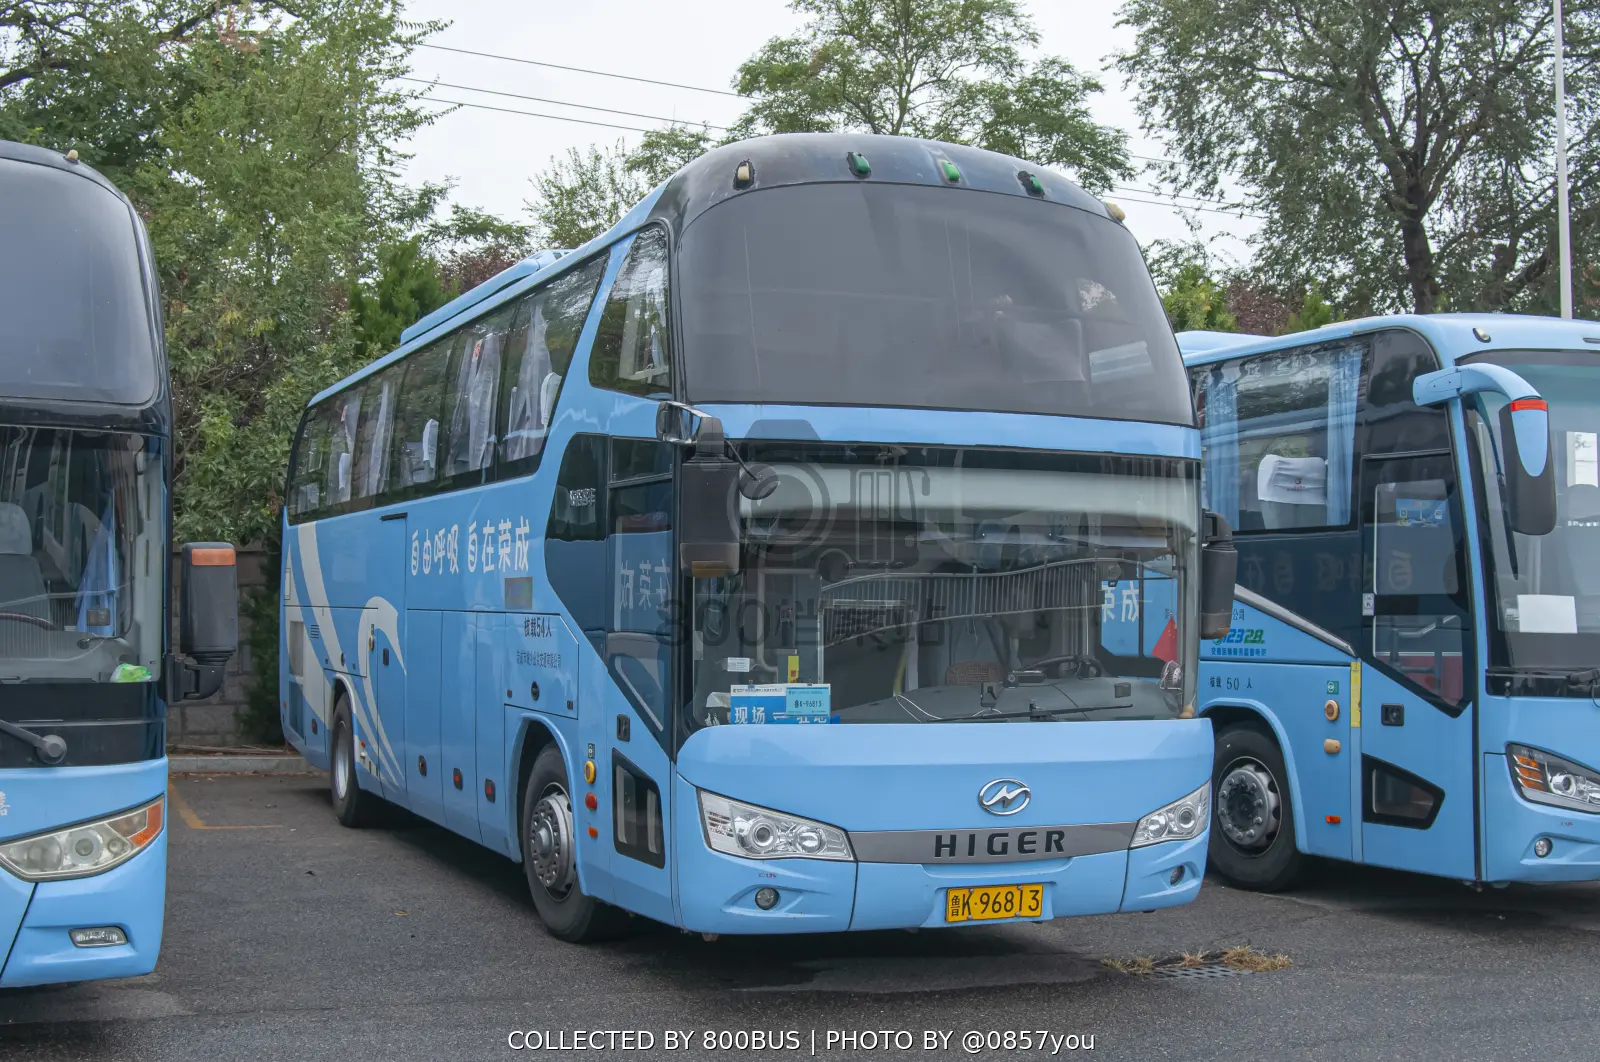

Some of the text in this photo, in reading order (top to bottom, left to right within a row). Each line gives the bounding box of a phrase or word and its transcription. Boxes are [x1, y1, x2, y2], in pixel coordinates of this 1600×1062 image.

[411, 516, 530, 576] 自由呼吸 自在荣成
[524, 616, 552, 638] 核载54人
[1226, 677, 1240, 691] 50
[734, 706, 766, 725] 现场
[934, 830, 1066, 858] HIGER
